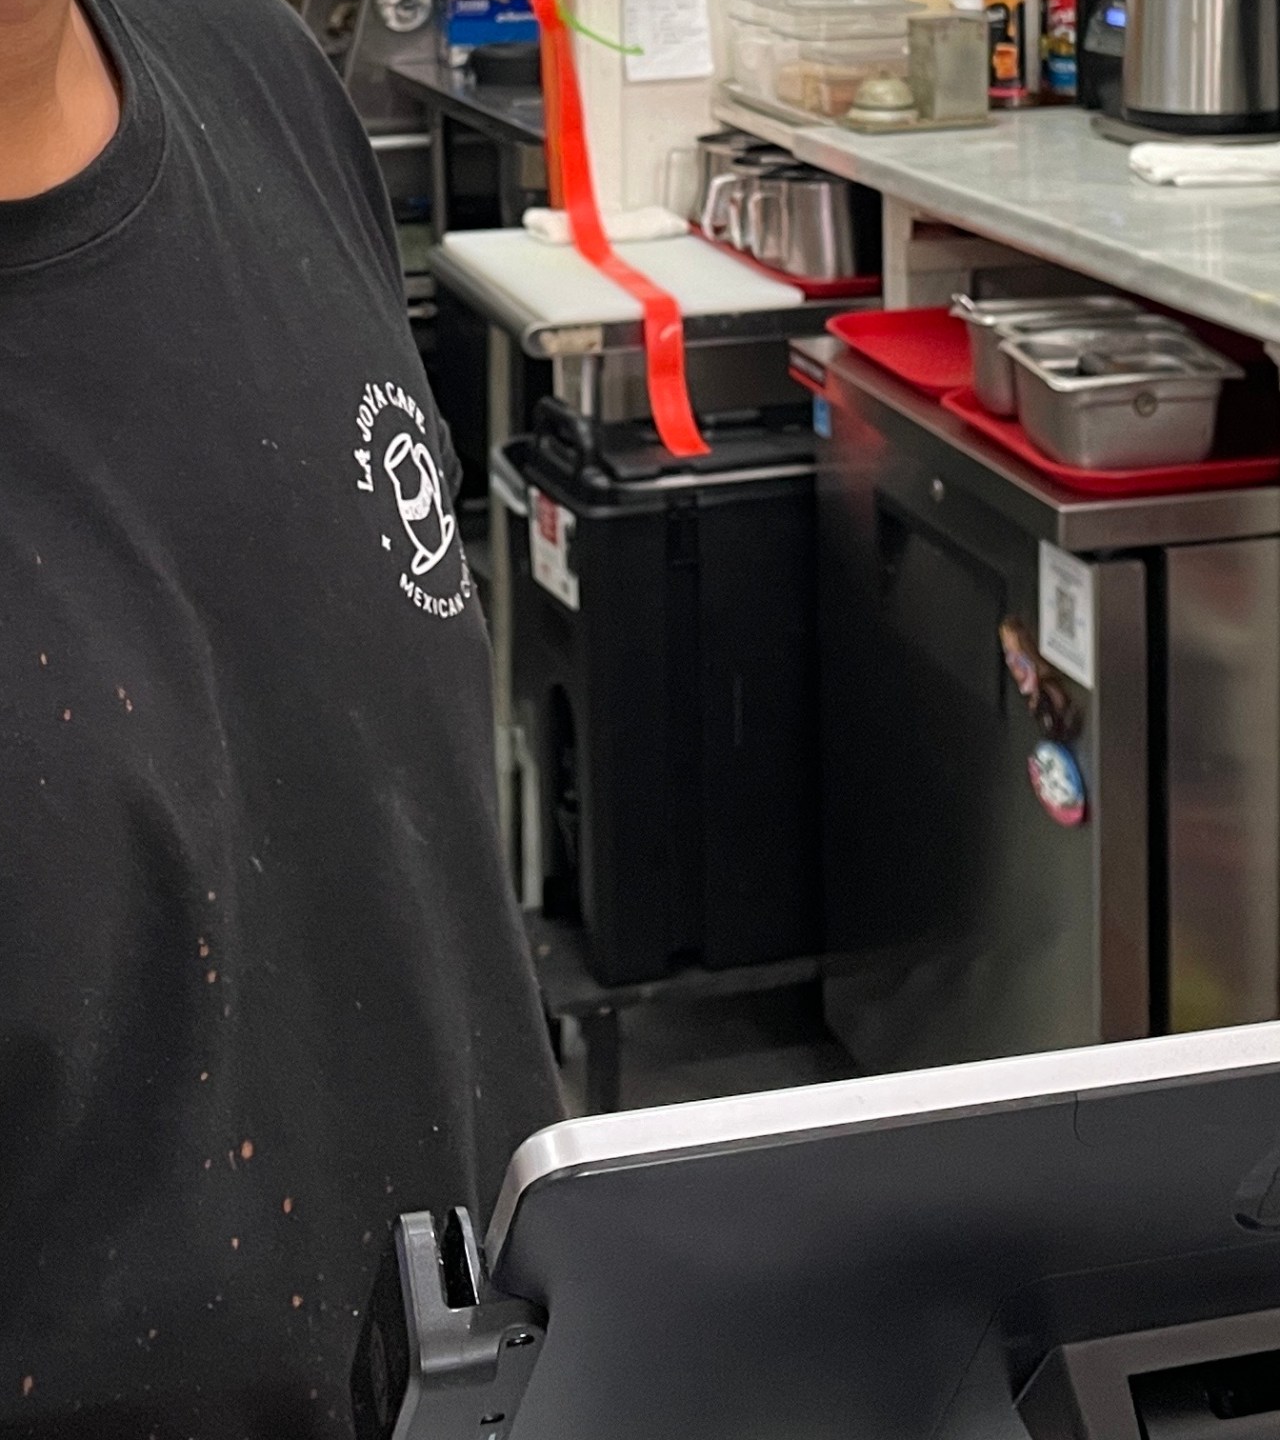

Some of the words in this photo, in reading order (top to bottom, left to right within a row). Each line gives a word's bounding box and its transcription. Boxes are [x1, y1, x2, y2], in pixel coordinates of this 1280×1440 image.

[356, 382, 389, 442] JOYA
[354, 448, 374, 492] LA
[399, 572, 465, 619] MEXICAN
